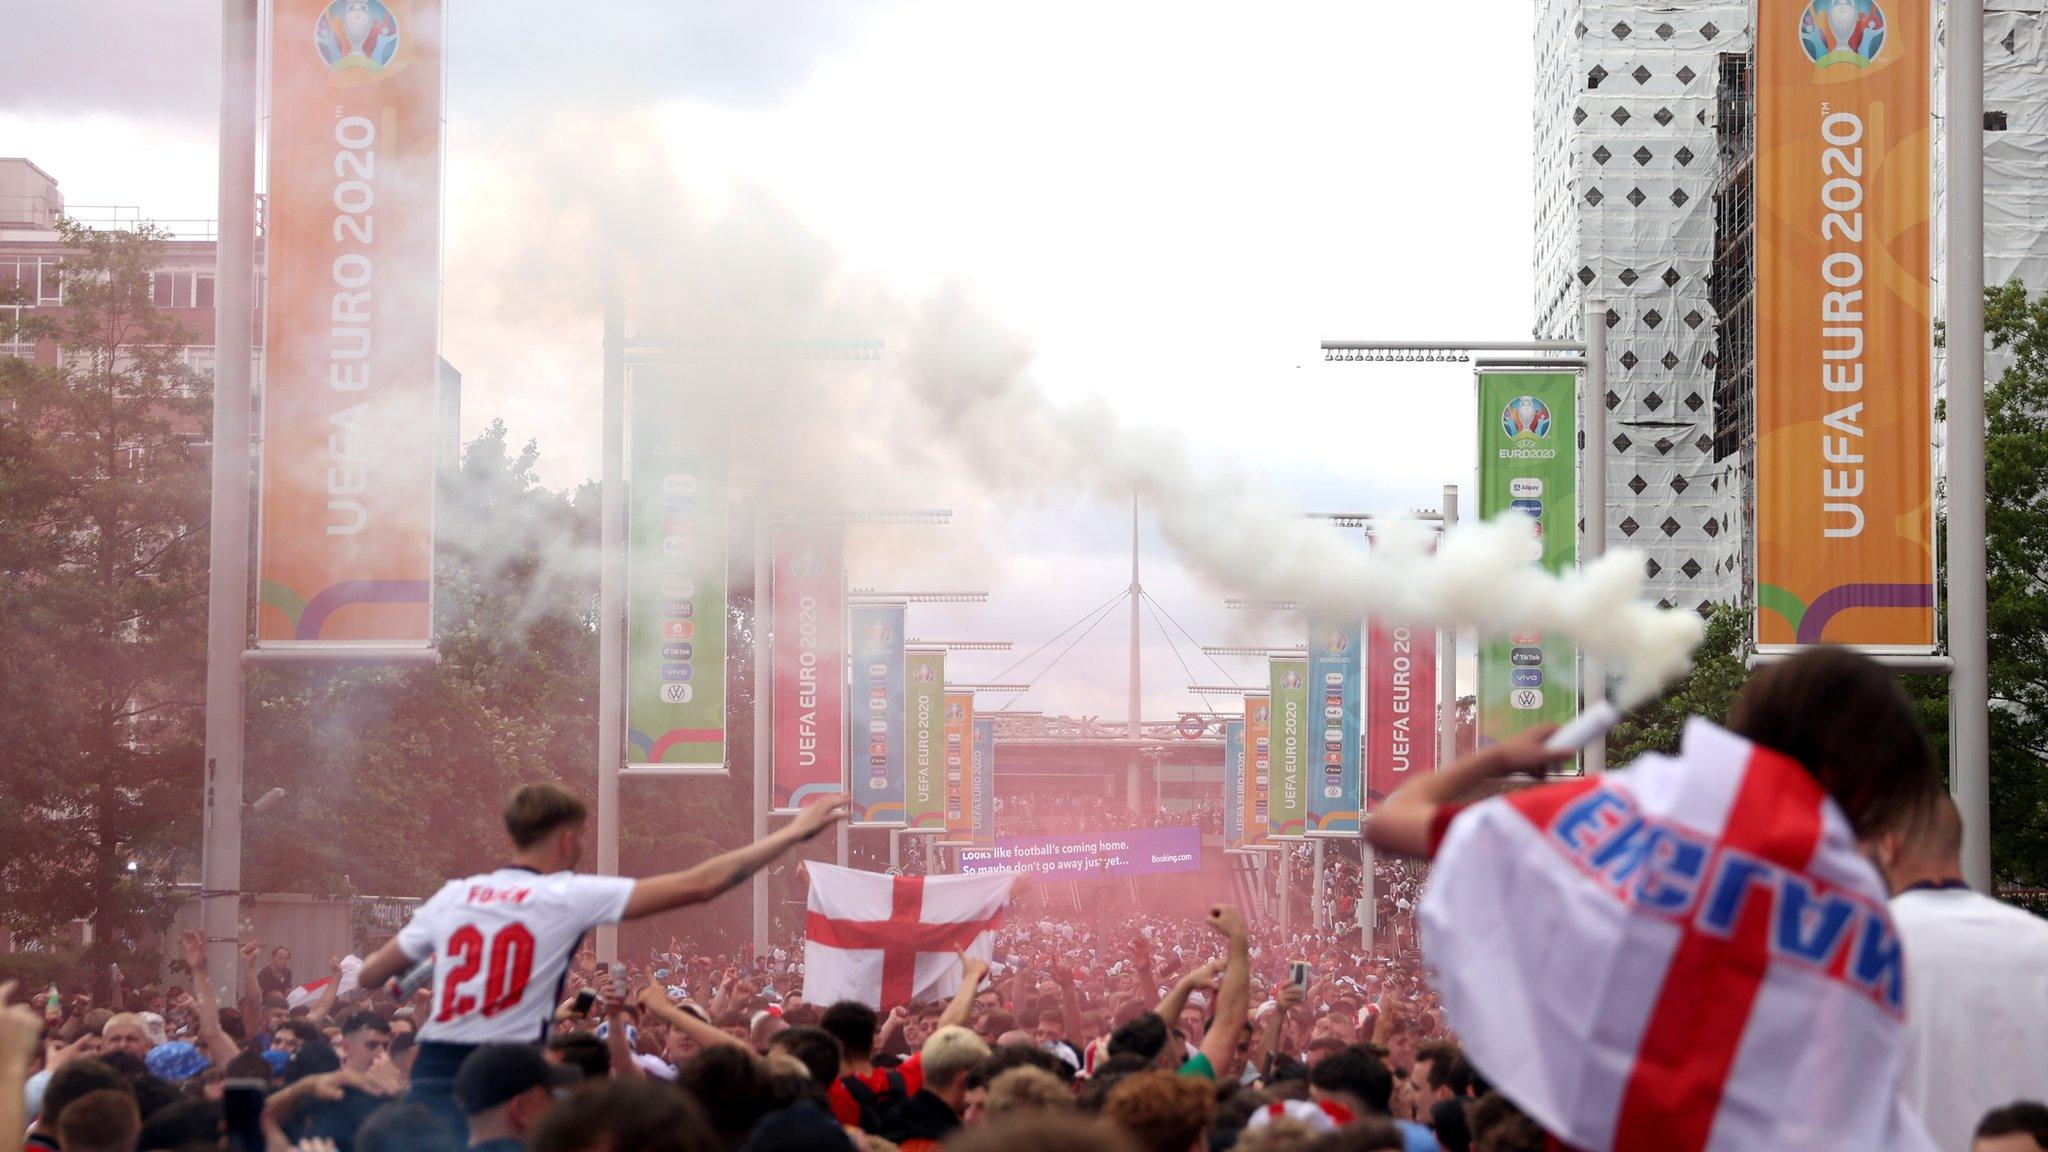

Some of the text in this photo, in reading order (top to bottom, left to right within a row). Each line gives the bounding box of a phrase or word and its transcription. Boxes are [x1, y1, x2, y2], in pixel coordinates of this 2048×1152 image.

[333, 114, 376, 244] 2020
[1820, 111, 1864, 243] 2020
[331, 253, 374, 391] EURO
[1820, 252, 1864, 392] EURO
[326, 400, 370, 535] UEFA
[1822, 401, 1865, 538] UEFA
[799, 595, 817, 767] UEFA EURO 2020
[1392, 656, 1410, 714] EURO
[1520, 653, 1541, 661] TikTok
[918, 694, 930, 802] UEFA EURO 2020
[973, 750, 982, 830] UEFA EURO 2020
[1285, 701, 1297, 809] UEFA EURO 2020
[1392, 716, 1410, 772] UEFA
[962, 864, 976, 877] So
[1013, 860, 1041, 873] don't
[1042, 861, 1057, 873] go
[1057, 859, 1084, 872] away
[1084, 856, 1103, 871] jus
[993, 846, 1013, 859] like
[1014, 843, 1060, 858] football's
[1061, 841, 1098, 856] coming
[1099, 840, 1130, 852] home.
[1151, 852, 1193, 867] Booking.com
[436, 920, 536, 1023] 20
